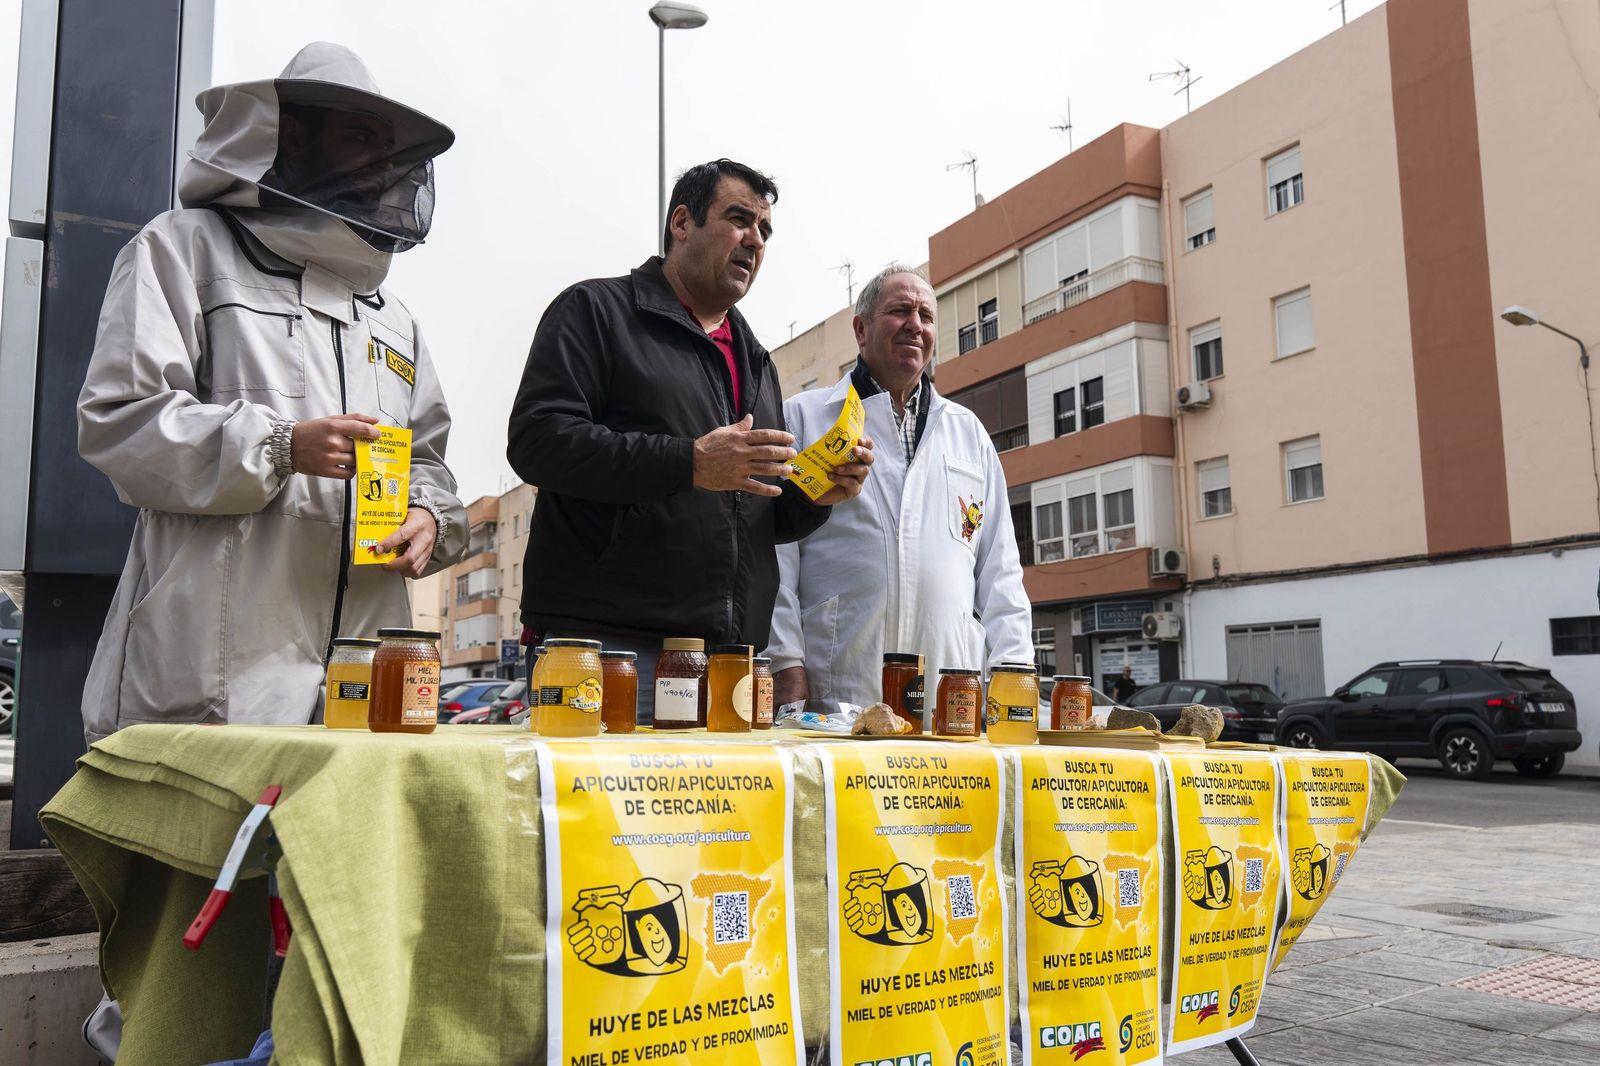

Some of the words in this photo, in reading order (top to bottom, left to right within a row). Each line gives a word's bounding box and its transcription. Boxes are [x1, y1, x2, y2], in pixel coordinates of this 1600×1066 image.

[629, 754, 686, 769] BUSCA
[693, 754, 714, 768] TU
[886, 756, 928, 770] BUSCA
[933, 757, 948, 769] TU
[1065, 761, 1098, 774] BUSCA
[1101, 763, 1114, 774] TU
[1204, 762, 1230, 774] BUSCA
[1232, 763, 1243, 775] TU
[1312, 767, 1333, 778] BUSCA
[1335, 768, 1344, 778] TU
[572, 775, 774, 793] APICULTOR/APICULTORA
[845, 775, 991, 790] APICULTOR/APICULTORA
[1031, 778, 1149, 793] APICULTOR/APICULTORA
[1181, 776, 1270, 791] APICULTOR/APICULTORA
[1292, 781, 1365, 793] APICULTOR/APICULTORA
[624, 800, 646, 816] DE
[651, 794, 737, 815] CERCANÍA:
[883, 796, 900, 811] DE
[903, 791, 964, 810] CERCANÍA:
[1062, 797, 1075, 810] DE
[1077, 794, 1128, 810] CERCANÍA:
[1204, 793, 1214, 805] DE
[1216, 792, 1255, 806] CERCANÍA:
[1310, 797, 1319, 807] DE
[1320, 795, 1351, 807] CERCANÍA:
[874, 822, 972, 837] www.coag.org/apicultura
[1054, 822, 1138, 833] www.coag.org/apicultura
[612, 829, 751, 846] www.coag.org/apicultura
[1189, 932, 1210, 946] HUYE
[1211, 931, 1221, 943] DE
[1222, 930, 1235, 942] LAS
[1236, 925, 1266, 940] MEZCLAS
[1043, 953, 1076, 969] HUYE
[1079, 951, 1093, 966] DE
[1095, 949, 1114, 964] LAS
[1115, 946, 1152, 962] MEZCLAS
[1181, 955, 1196, 966] MIEL
[1196, 954, 1204, 964] DE
[1205, 952, 1227, 964] VERDAD
[1227, 951, 1232, 960] Y
[1233, 950, 1239, 959] DE
[1240, 945, 1267, 958] PROXIMIDAD
[860, 975, 900, 995] HUYE
[905, 972, 921, 989] DE
[924, 968, 946, 987] LAS
[949, 961, 994, 983] MEZCLAS
[1033, 979, 1056, 992] MIEL
[1058, 978, 1070, 990] DE
[1072, 975, 1105, 989] VERDAD
[1106, 974, 1112, 985] Y
[1114, 972, 1123, 984] DE
[1124, 967, 1157, 982] PROXIMIDAD
[847, 1006, 875, 1023] MIEL
[879, 1004, 893, 1018] DE
[896, 997, 936, 1016] VERDAD
[938, 997, 946, 1009] Y
[947, 995, 958, 1008] DE
[960, 986, 1002, 1006] PROXIMIDAD
[1181, 990, 1219, 1013] COAG
[589, 1013, 641, 1037] HUYE
[648, 1009, 668, 1027] DE
[673, 1004, 702, 1024] LAS
[707, 993, 775, 1019] MEZCLAS
[1041, 1022, 1101, 1048] COAG
[1136, 1030, 1155, 1049] CECU
[571, 1052, 607, 1066] MIEL
[613, 1049, 629, 1064] DE
[634, 1038, 687, 1061] VERDAD
[691, 1039, 699, 1052] Y
[703, 1034, 718, 1049] DE
[721, 1022, 789, 1047] PROXIMIDAD
